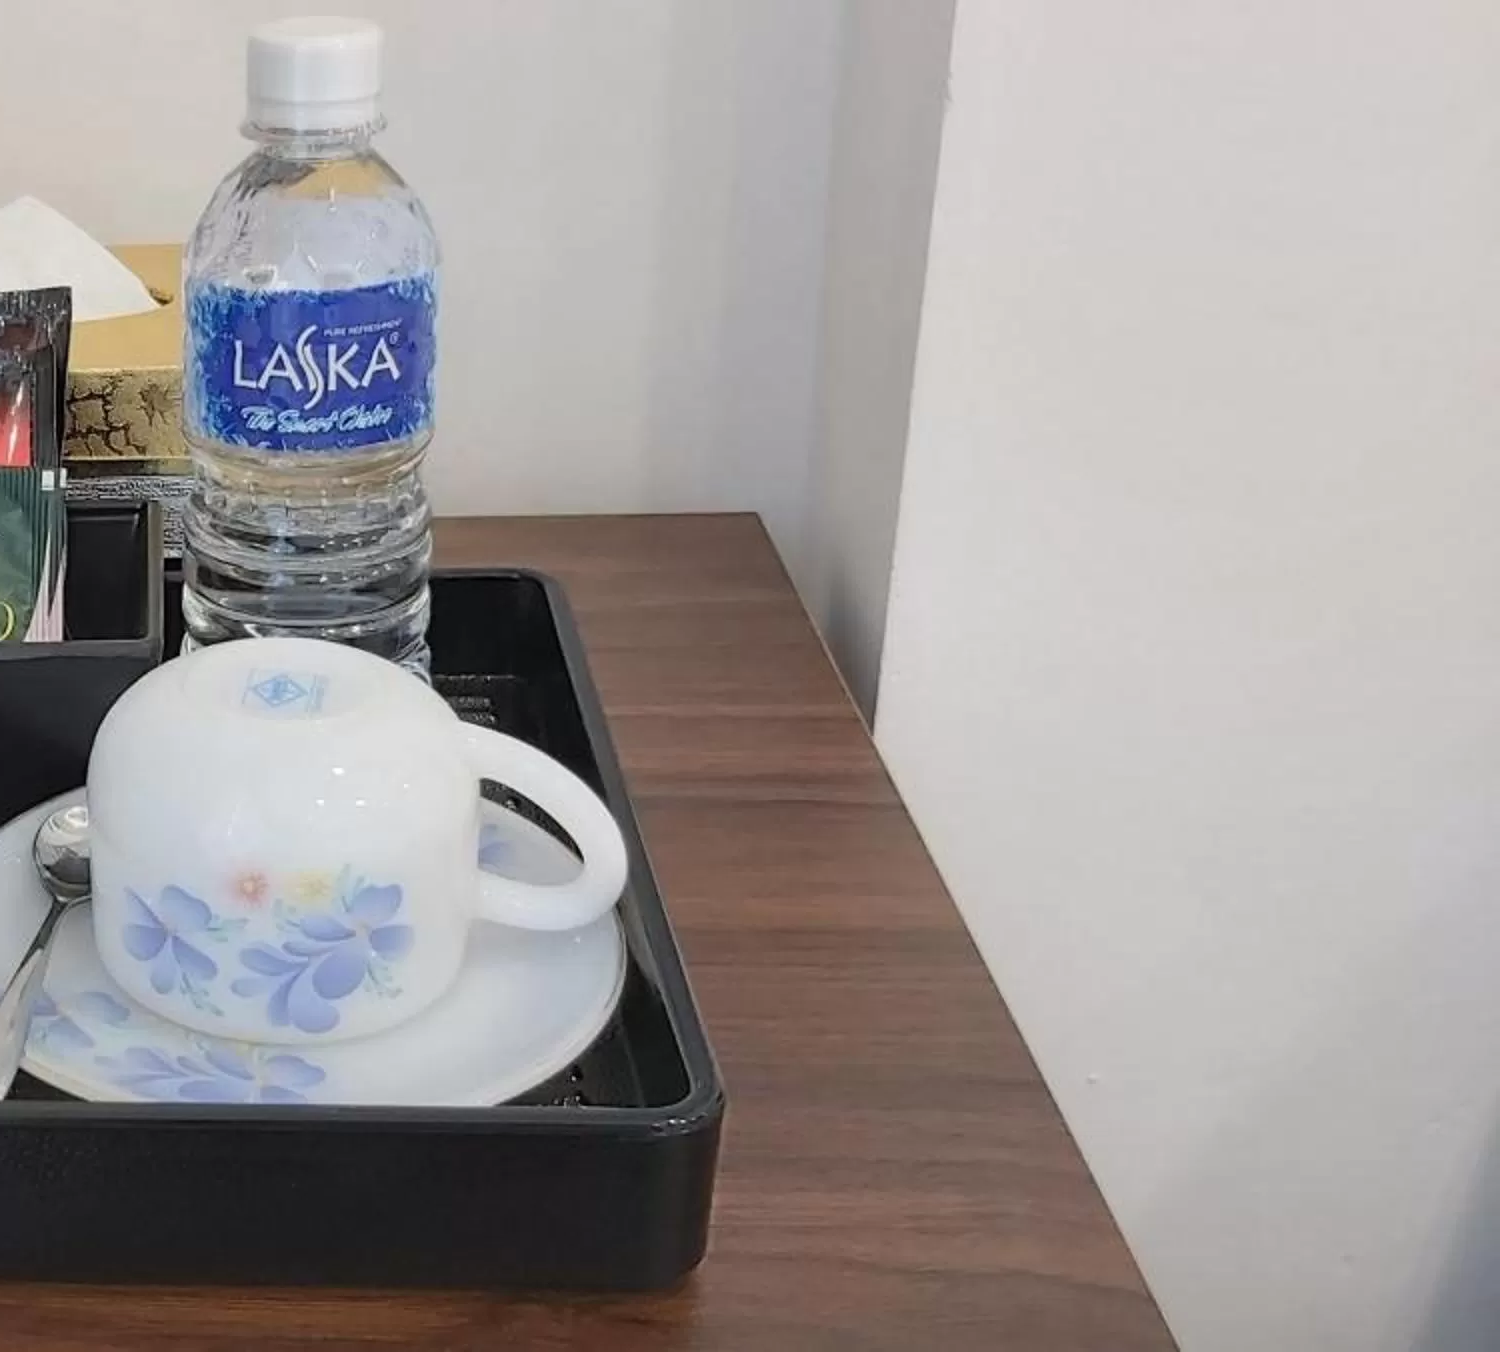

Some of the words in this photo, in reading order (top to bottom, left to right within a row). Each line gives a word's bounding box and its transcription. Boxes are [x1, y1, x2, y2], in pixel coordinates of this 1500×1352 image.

[233, 325, 401, 411] LASKA
[241, 406, 276, 431] The
[277, 407, 337, 432] Smart
